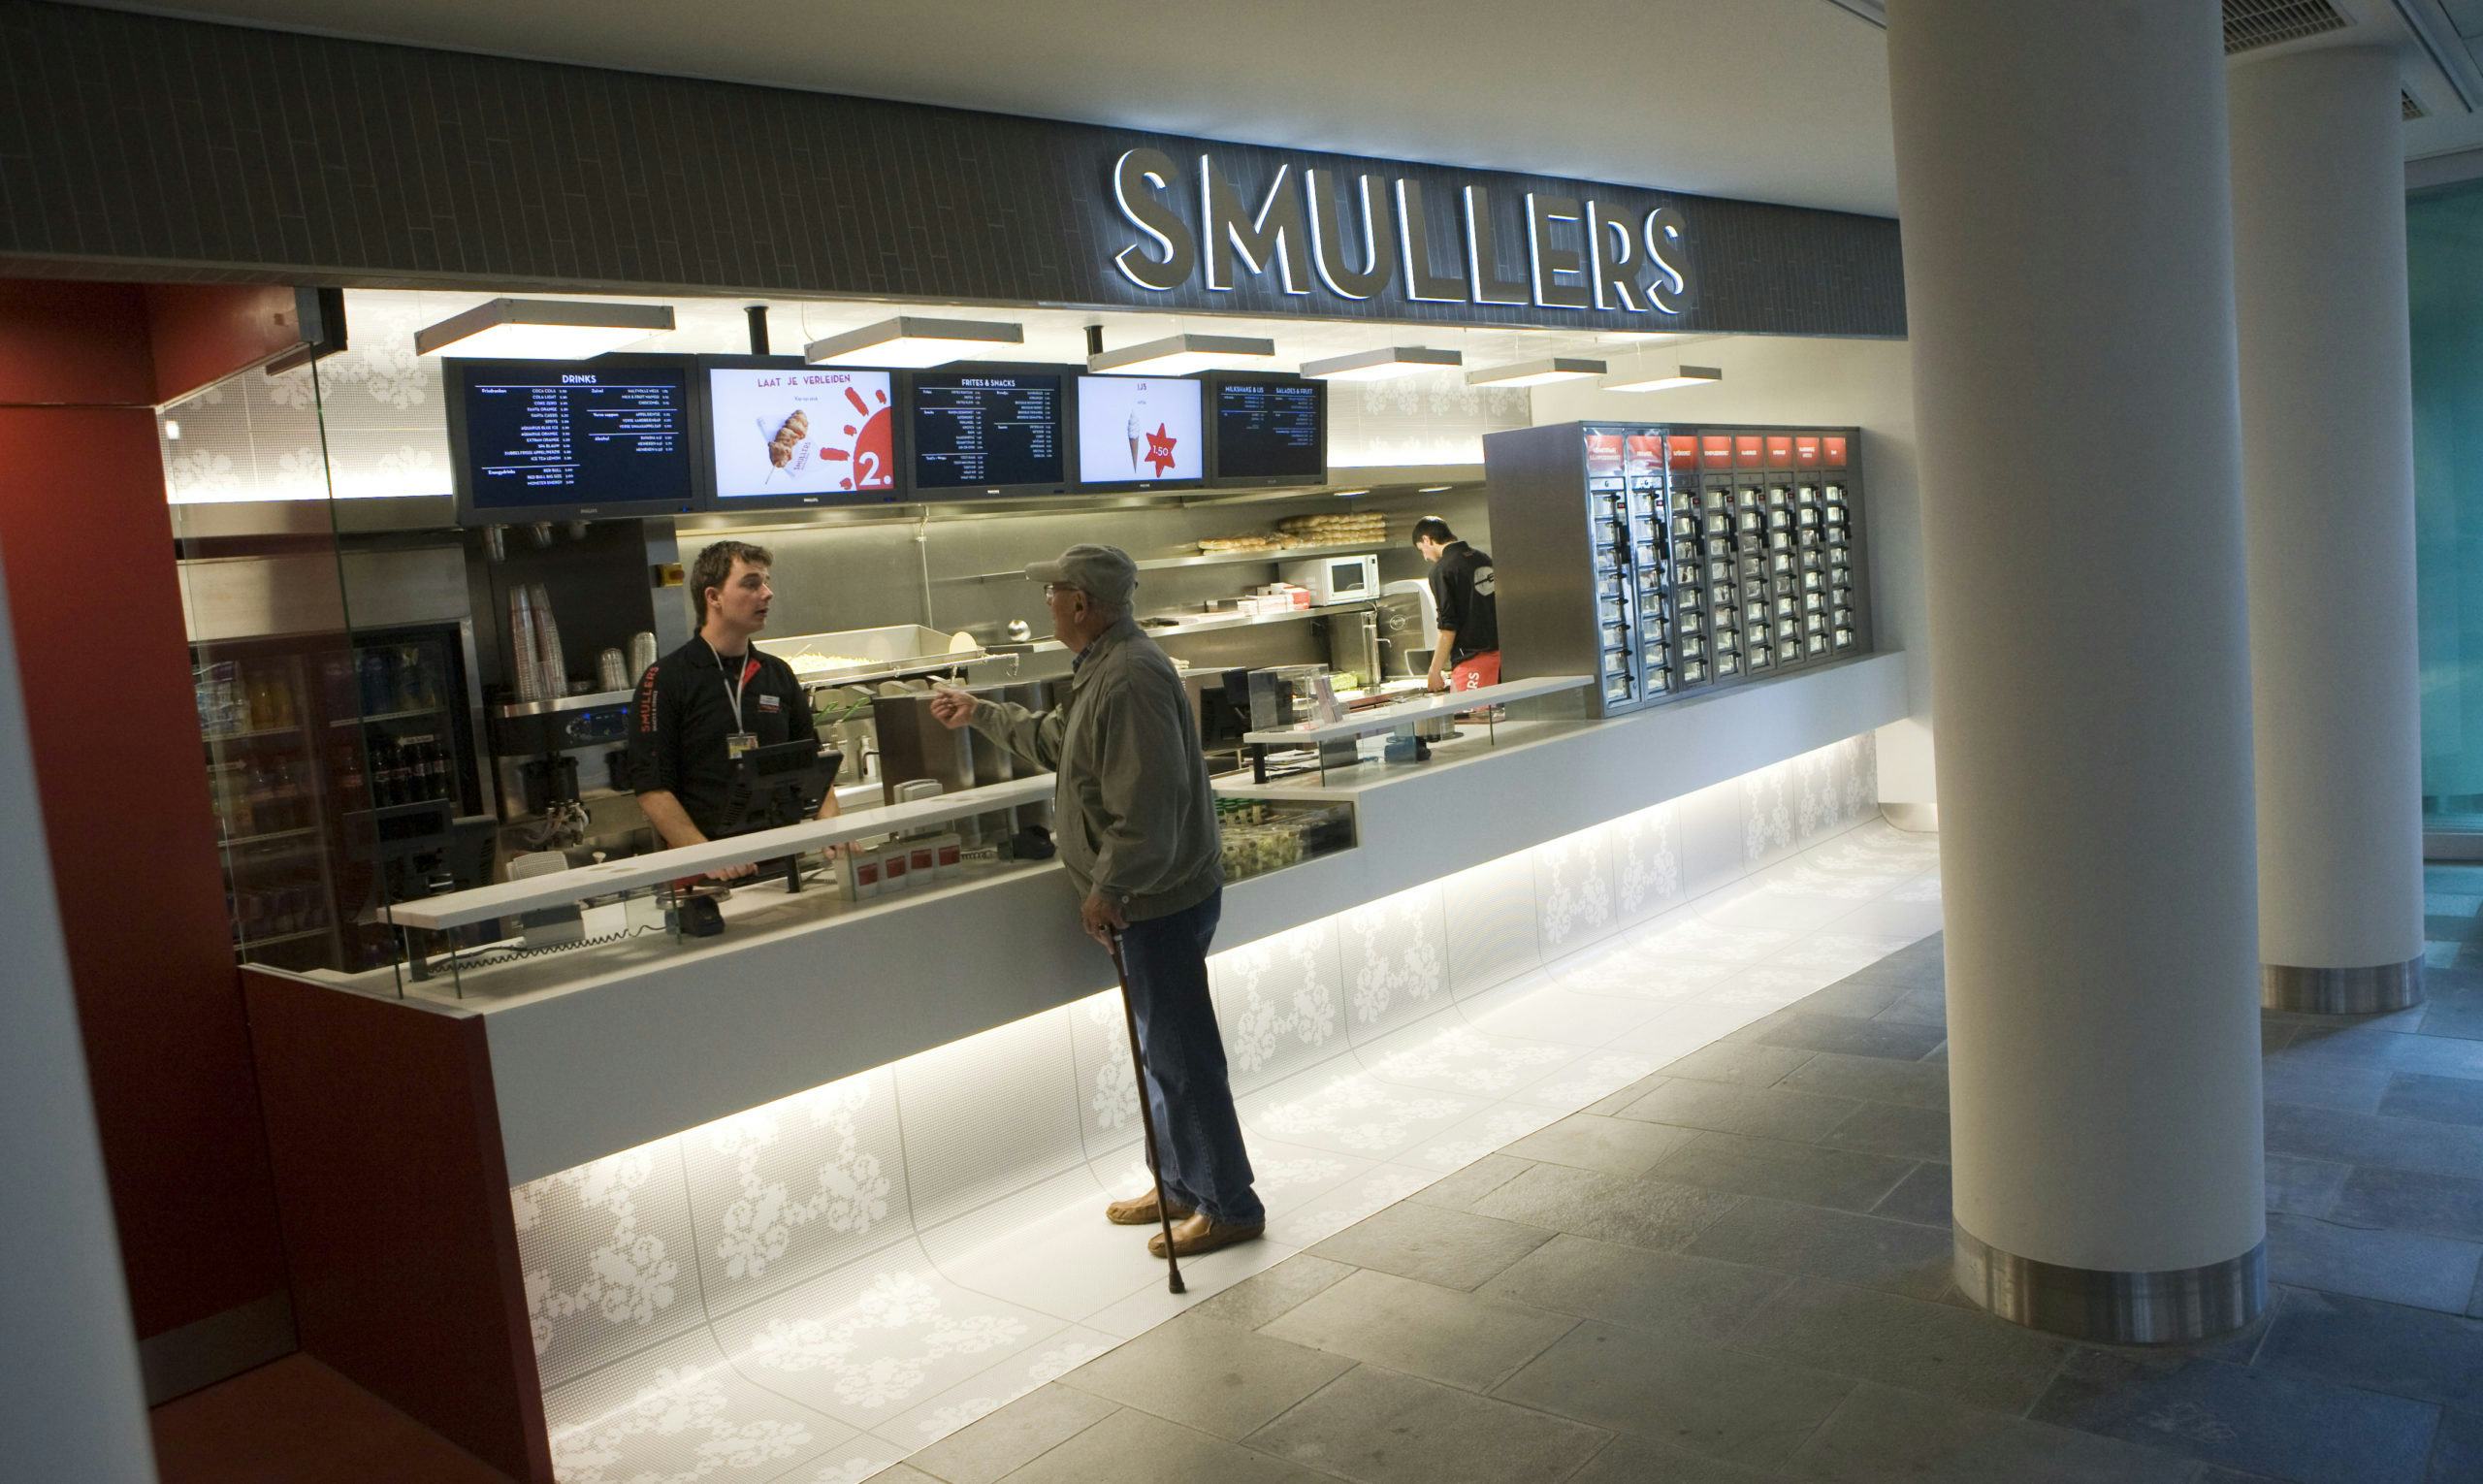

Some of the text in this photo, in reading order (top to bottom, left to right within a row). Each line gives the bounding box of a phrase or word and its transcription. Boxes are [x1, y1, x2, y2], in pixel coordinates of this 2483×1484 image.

[1113, 147, 1692, 315] SMULLERS
[563, 374, 597, 384] DRINKS
[758, 374, 851, 387] LAAT JE VERLEIDEN
[962, 378, 984, 387] FRITES
[1152, 444, 1169, 457] 1.50
[640, 666, 660, 731] SMULLERS
